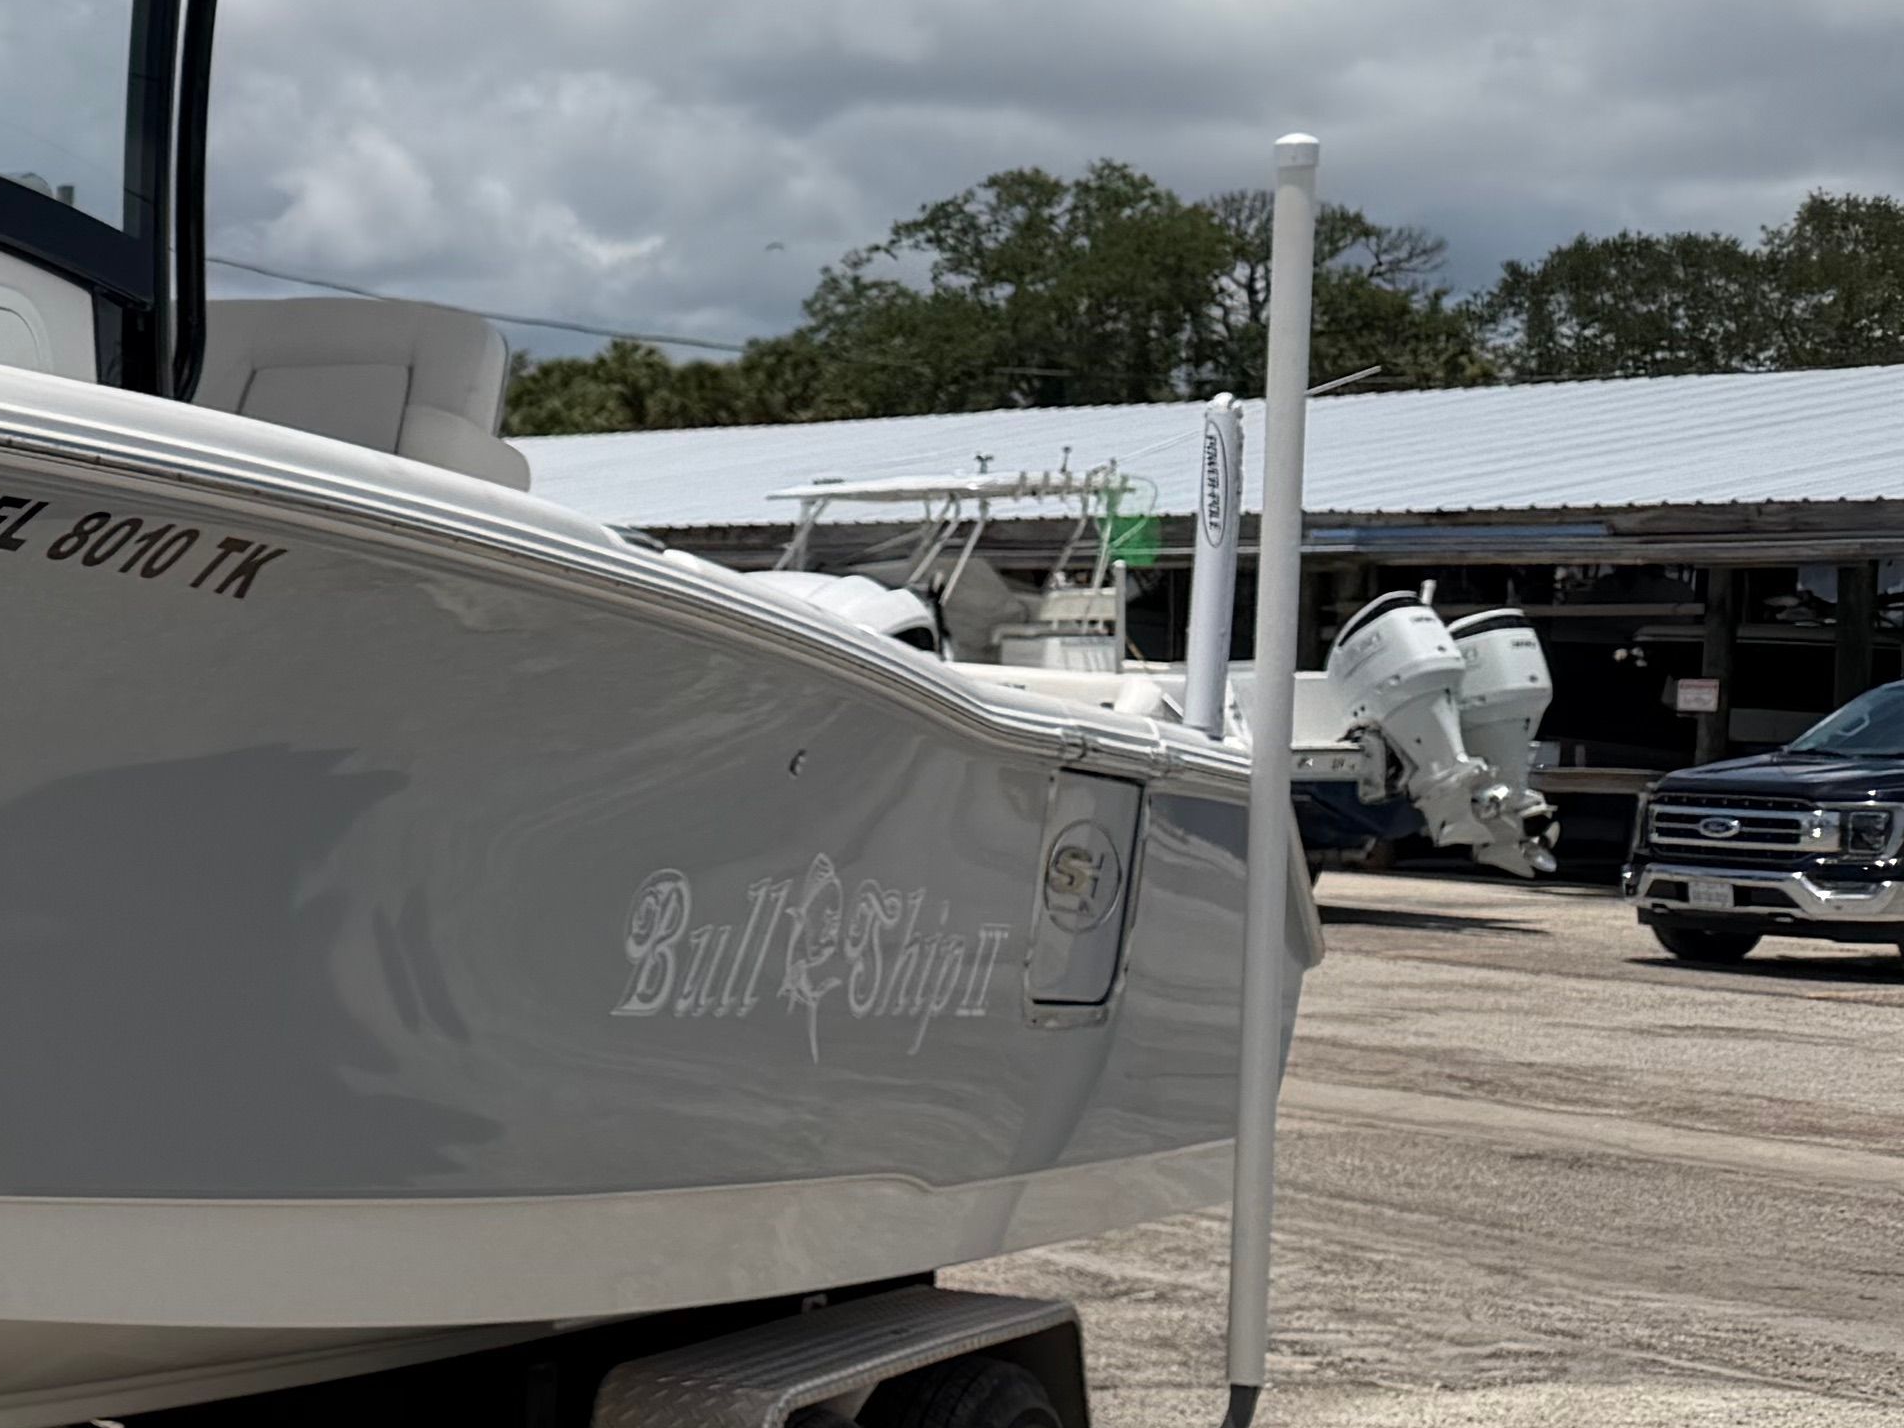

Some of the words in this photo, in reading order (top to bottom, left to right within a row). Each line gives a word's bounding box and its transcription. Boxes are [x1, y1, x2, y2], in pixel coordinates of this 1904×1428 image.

[46, 511, 200, 579] 8010
[189, 536, 288, 600] TK
[609, 868, 793, 1019] Bull
